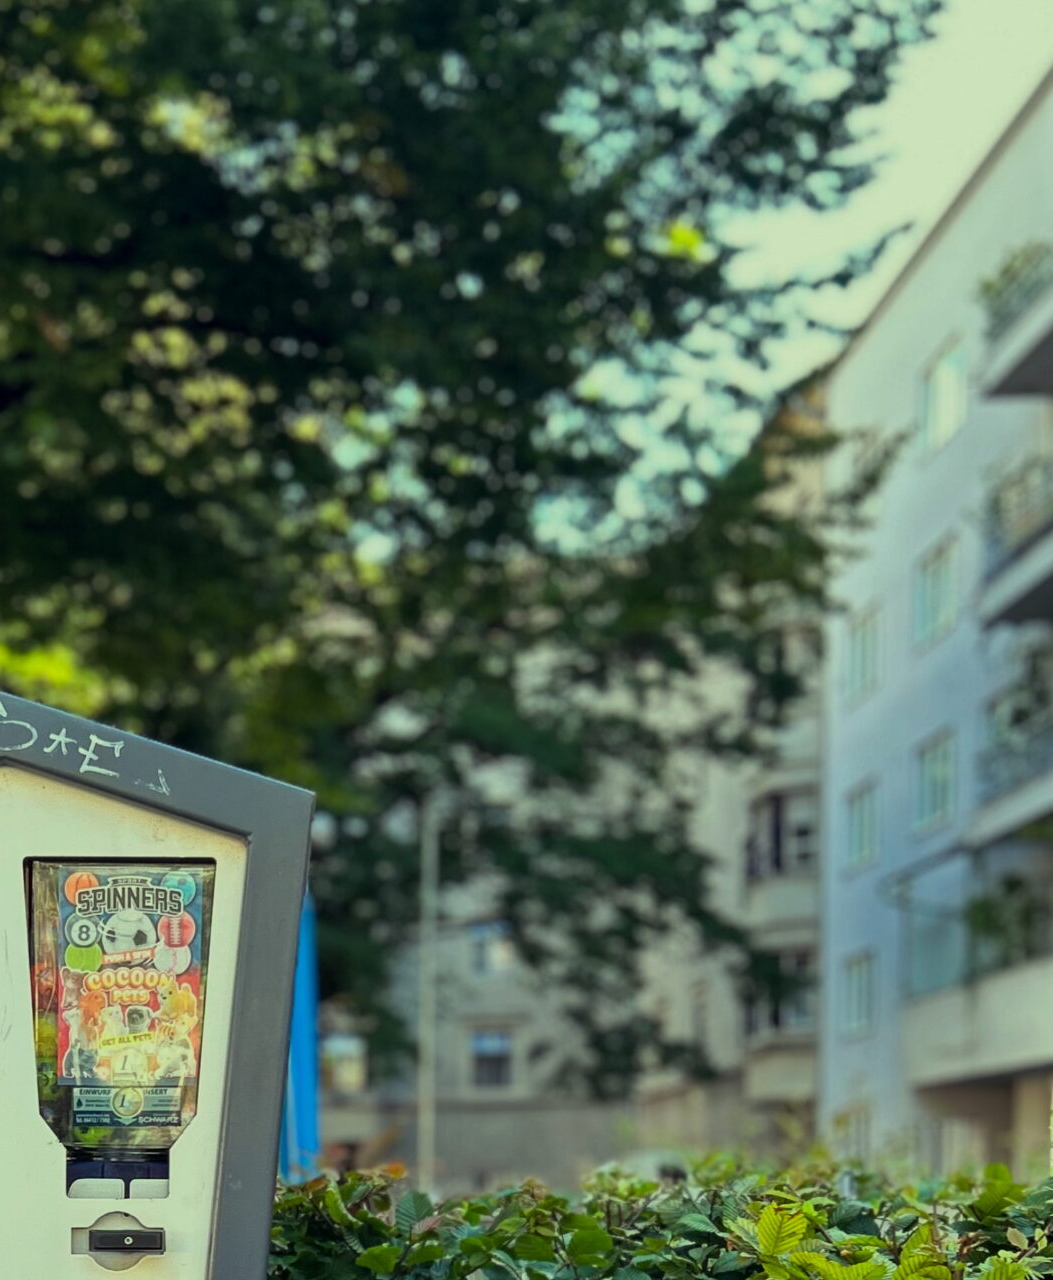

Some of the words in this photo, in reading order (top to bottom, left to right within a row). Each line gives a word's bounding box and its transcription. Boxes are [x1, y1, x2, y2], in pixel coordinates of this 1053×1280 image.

[77, 886, 182, 917] SPINNERS
[78, 924, 90, 941] 8
[84, 968, 173, 989] COCOON
[112, 988, 147, 1003] PETS
[102, 1037, 117, 1046] GET
[118, 1035, 133, 1044] ALL
[134, 1033, 152, 1042] PETS
